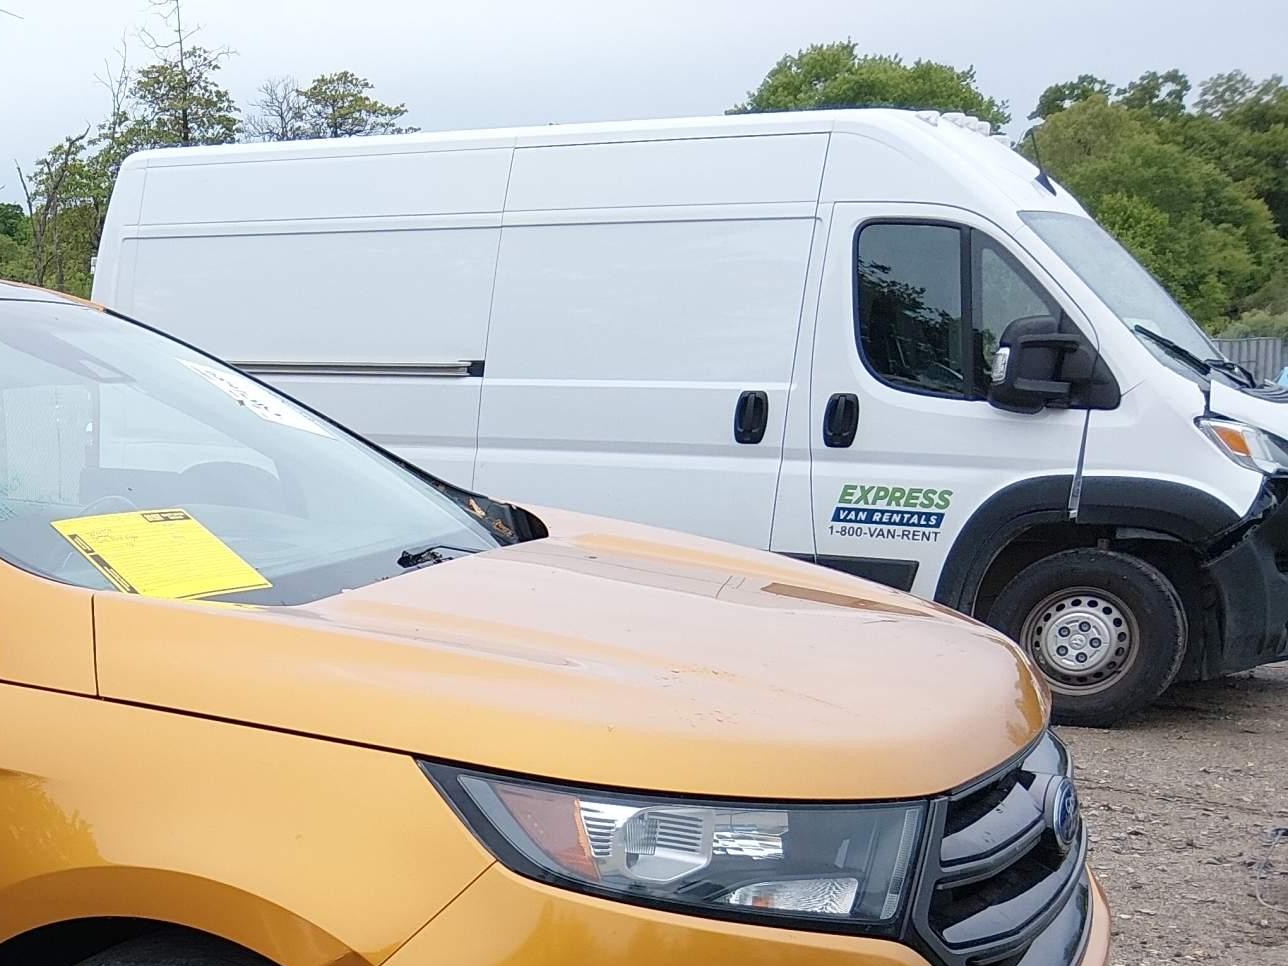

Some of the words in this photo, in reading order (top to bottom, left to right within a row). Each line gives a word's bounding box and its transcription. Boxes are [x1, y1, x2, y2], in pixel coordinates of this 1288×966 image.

[838, 484, 954, 510] EXPRESS
[839, 510, 867, 521] VAN
[872, 512, 937, 525] RENTALS
[829, 525, 941, 542] 1-800-VAN-RENT
